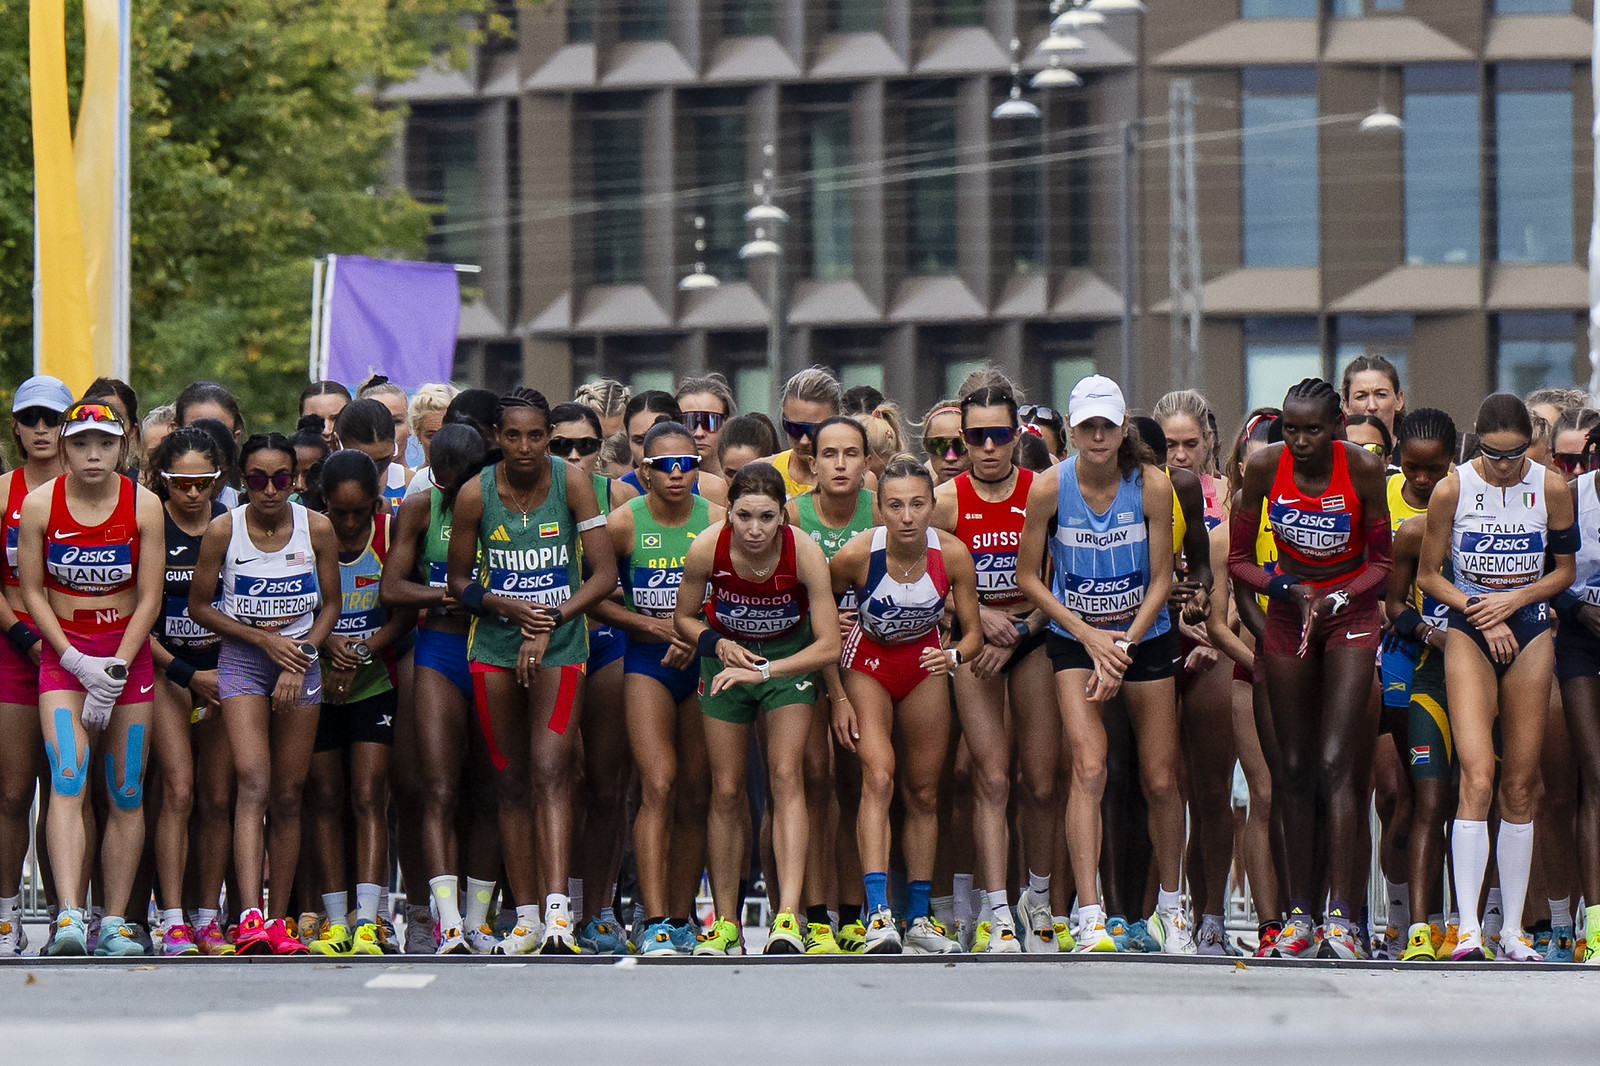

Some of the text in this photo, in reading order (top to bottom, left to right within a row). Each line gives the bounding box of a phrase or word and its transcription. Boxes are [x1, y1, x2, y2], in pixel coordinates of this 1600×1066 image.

[1299, 514, 1336, 529] asics
[1481, 523, 1527, 533] ITALIA
[1075, 530, 1128, 546] URUGUAY
[1273, 523, 1345, 546] NGETICH
[1493, 537, 1530, 551] asics
[79, 550, 116, 563] asics
[488, 545, 569, 571] ETHIOPIA
[1463, 554, 1540, 573] YAREMCHUK
[54, 566, 123, 583] LIANG
[518, 573, 554, 589] asics
[267, 579, 302, 594] asics
[1095, 577, 1130, 592] asics
[636, 591, 678, 607] DE OLIVE
[718, 588, 792, 606] MOROCCO
[1068, 589, 1140, 612] PATERNAIN
[236, 598, 272, 616] KELATI
[273, 595, 315, 615] FREZGHI
[748, 608, 784, 618] asics
[720, 616, 796, 632] BIRDAHA
